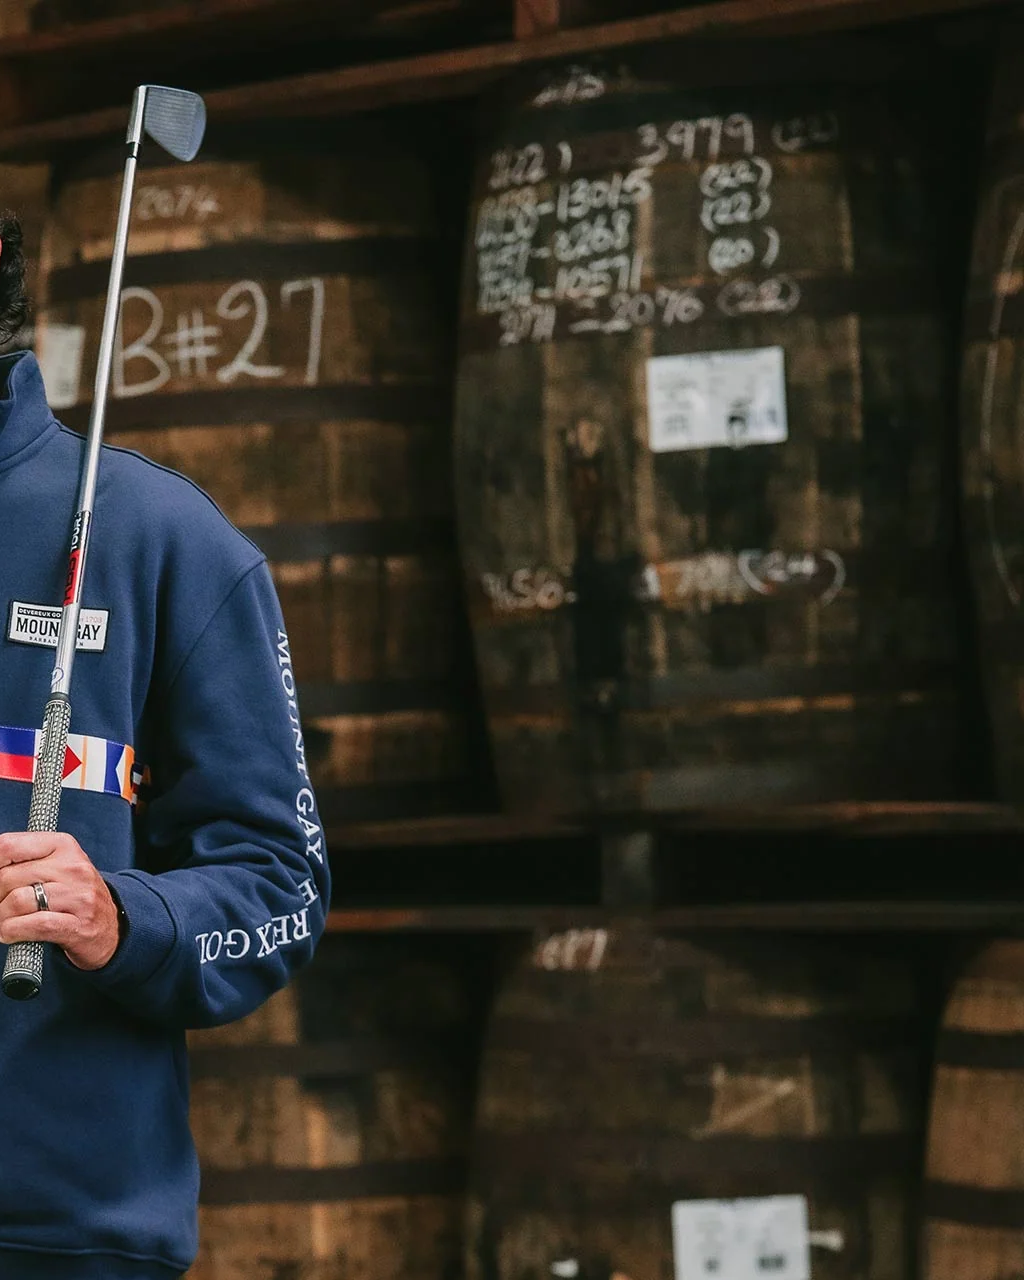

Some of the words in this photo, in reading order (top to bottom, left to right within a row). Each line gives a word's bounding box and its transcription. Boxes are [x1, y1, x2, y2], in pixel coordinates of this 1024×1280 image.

[113, 278, 326, 399] B#27
[18, 607, 51, 618] DEVEREUX
[16, 617, 60, 637] MOUN
[29, 636, 57, 644] BARBAD
[296, 787, 324, 865] GAY
